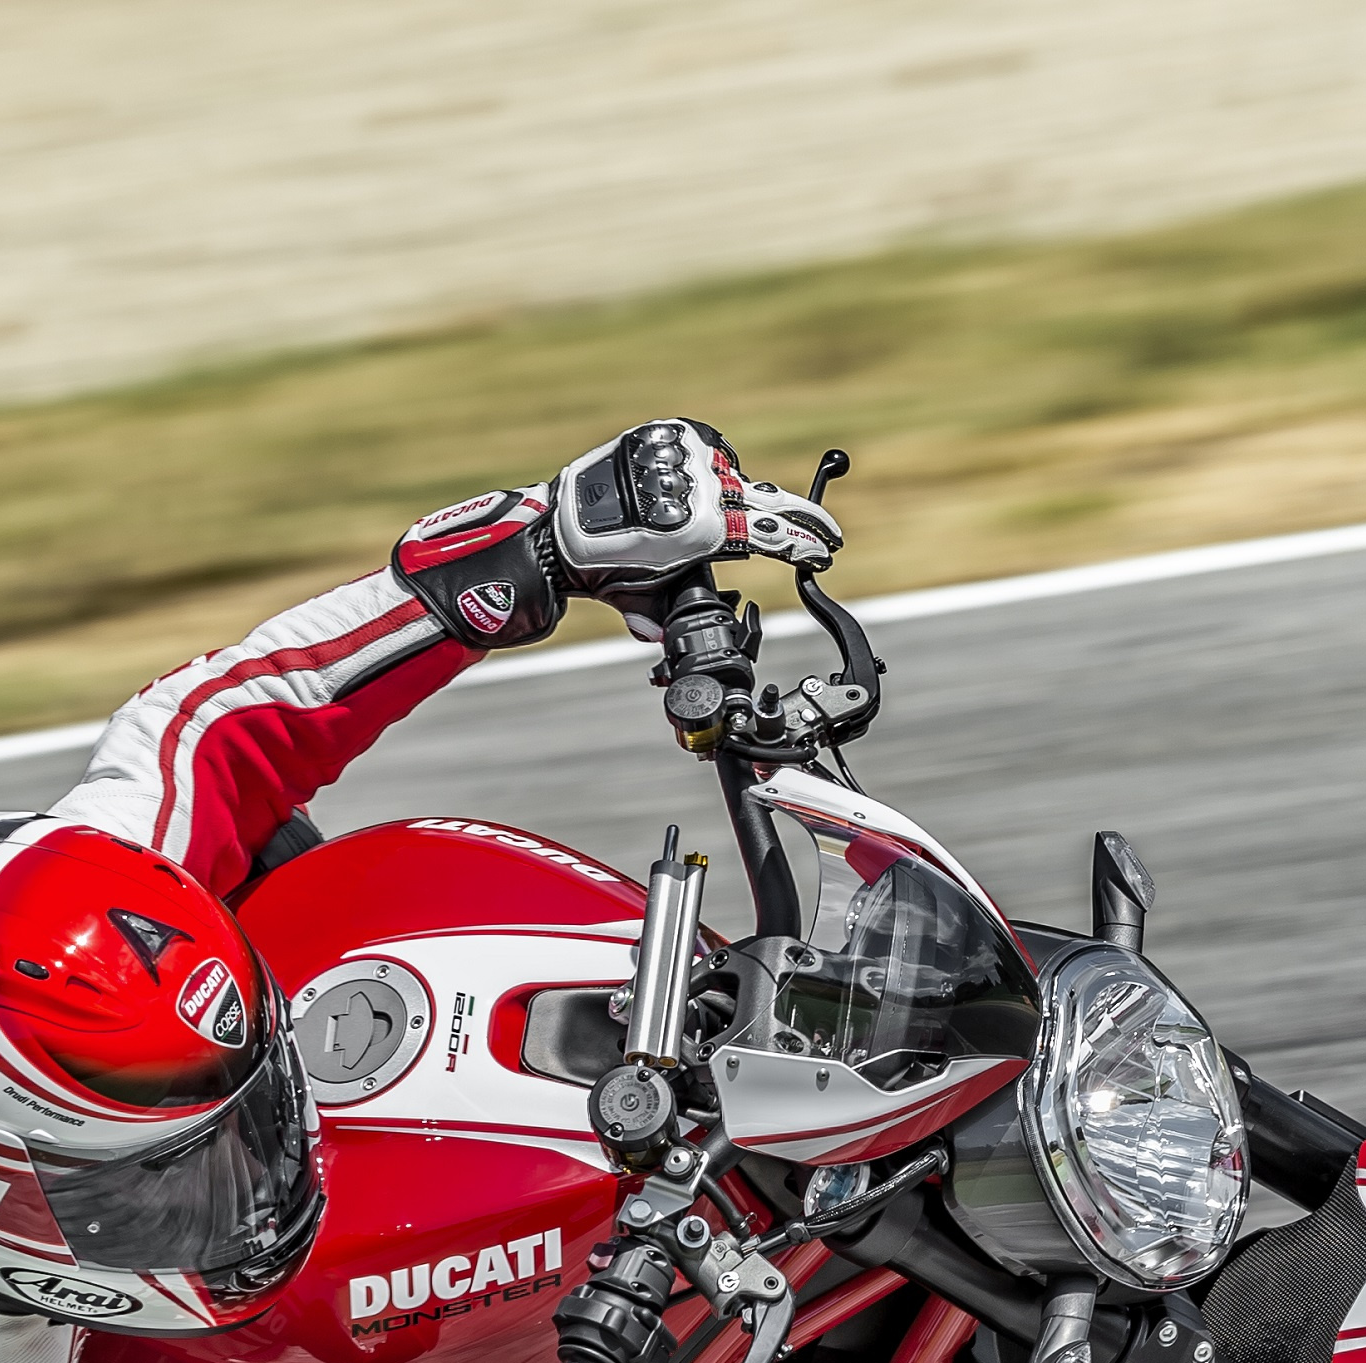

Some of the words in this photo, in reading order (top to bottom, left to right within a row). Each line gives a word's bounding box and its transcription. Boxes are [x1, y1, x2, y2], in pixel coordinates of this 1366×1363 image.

[423, 496, 496, 529] DUCATI
[786, 527, 817, 544] DUCATI
[462, 596, 498, 630] DUCATI
[406, 819, 622, 883] DUCATI
[184, 964, 225, 1018] DUCATI
[215, 1001, 241, 1037] CORSE
[3, 1086, 30, 1104] Drudi
[26, 1100, 86, 1127] Performance
[349, 1227, 563, 1320] DUCATI
[8, 1277, 127, 1310] Arai
[40, 1295, 96, 1313] HELMET
[351, 1273, 562, 1338] MONSTER
